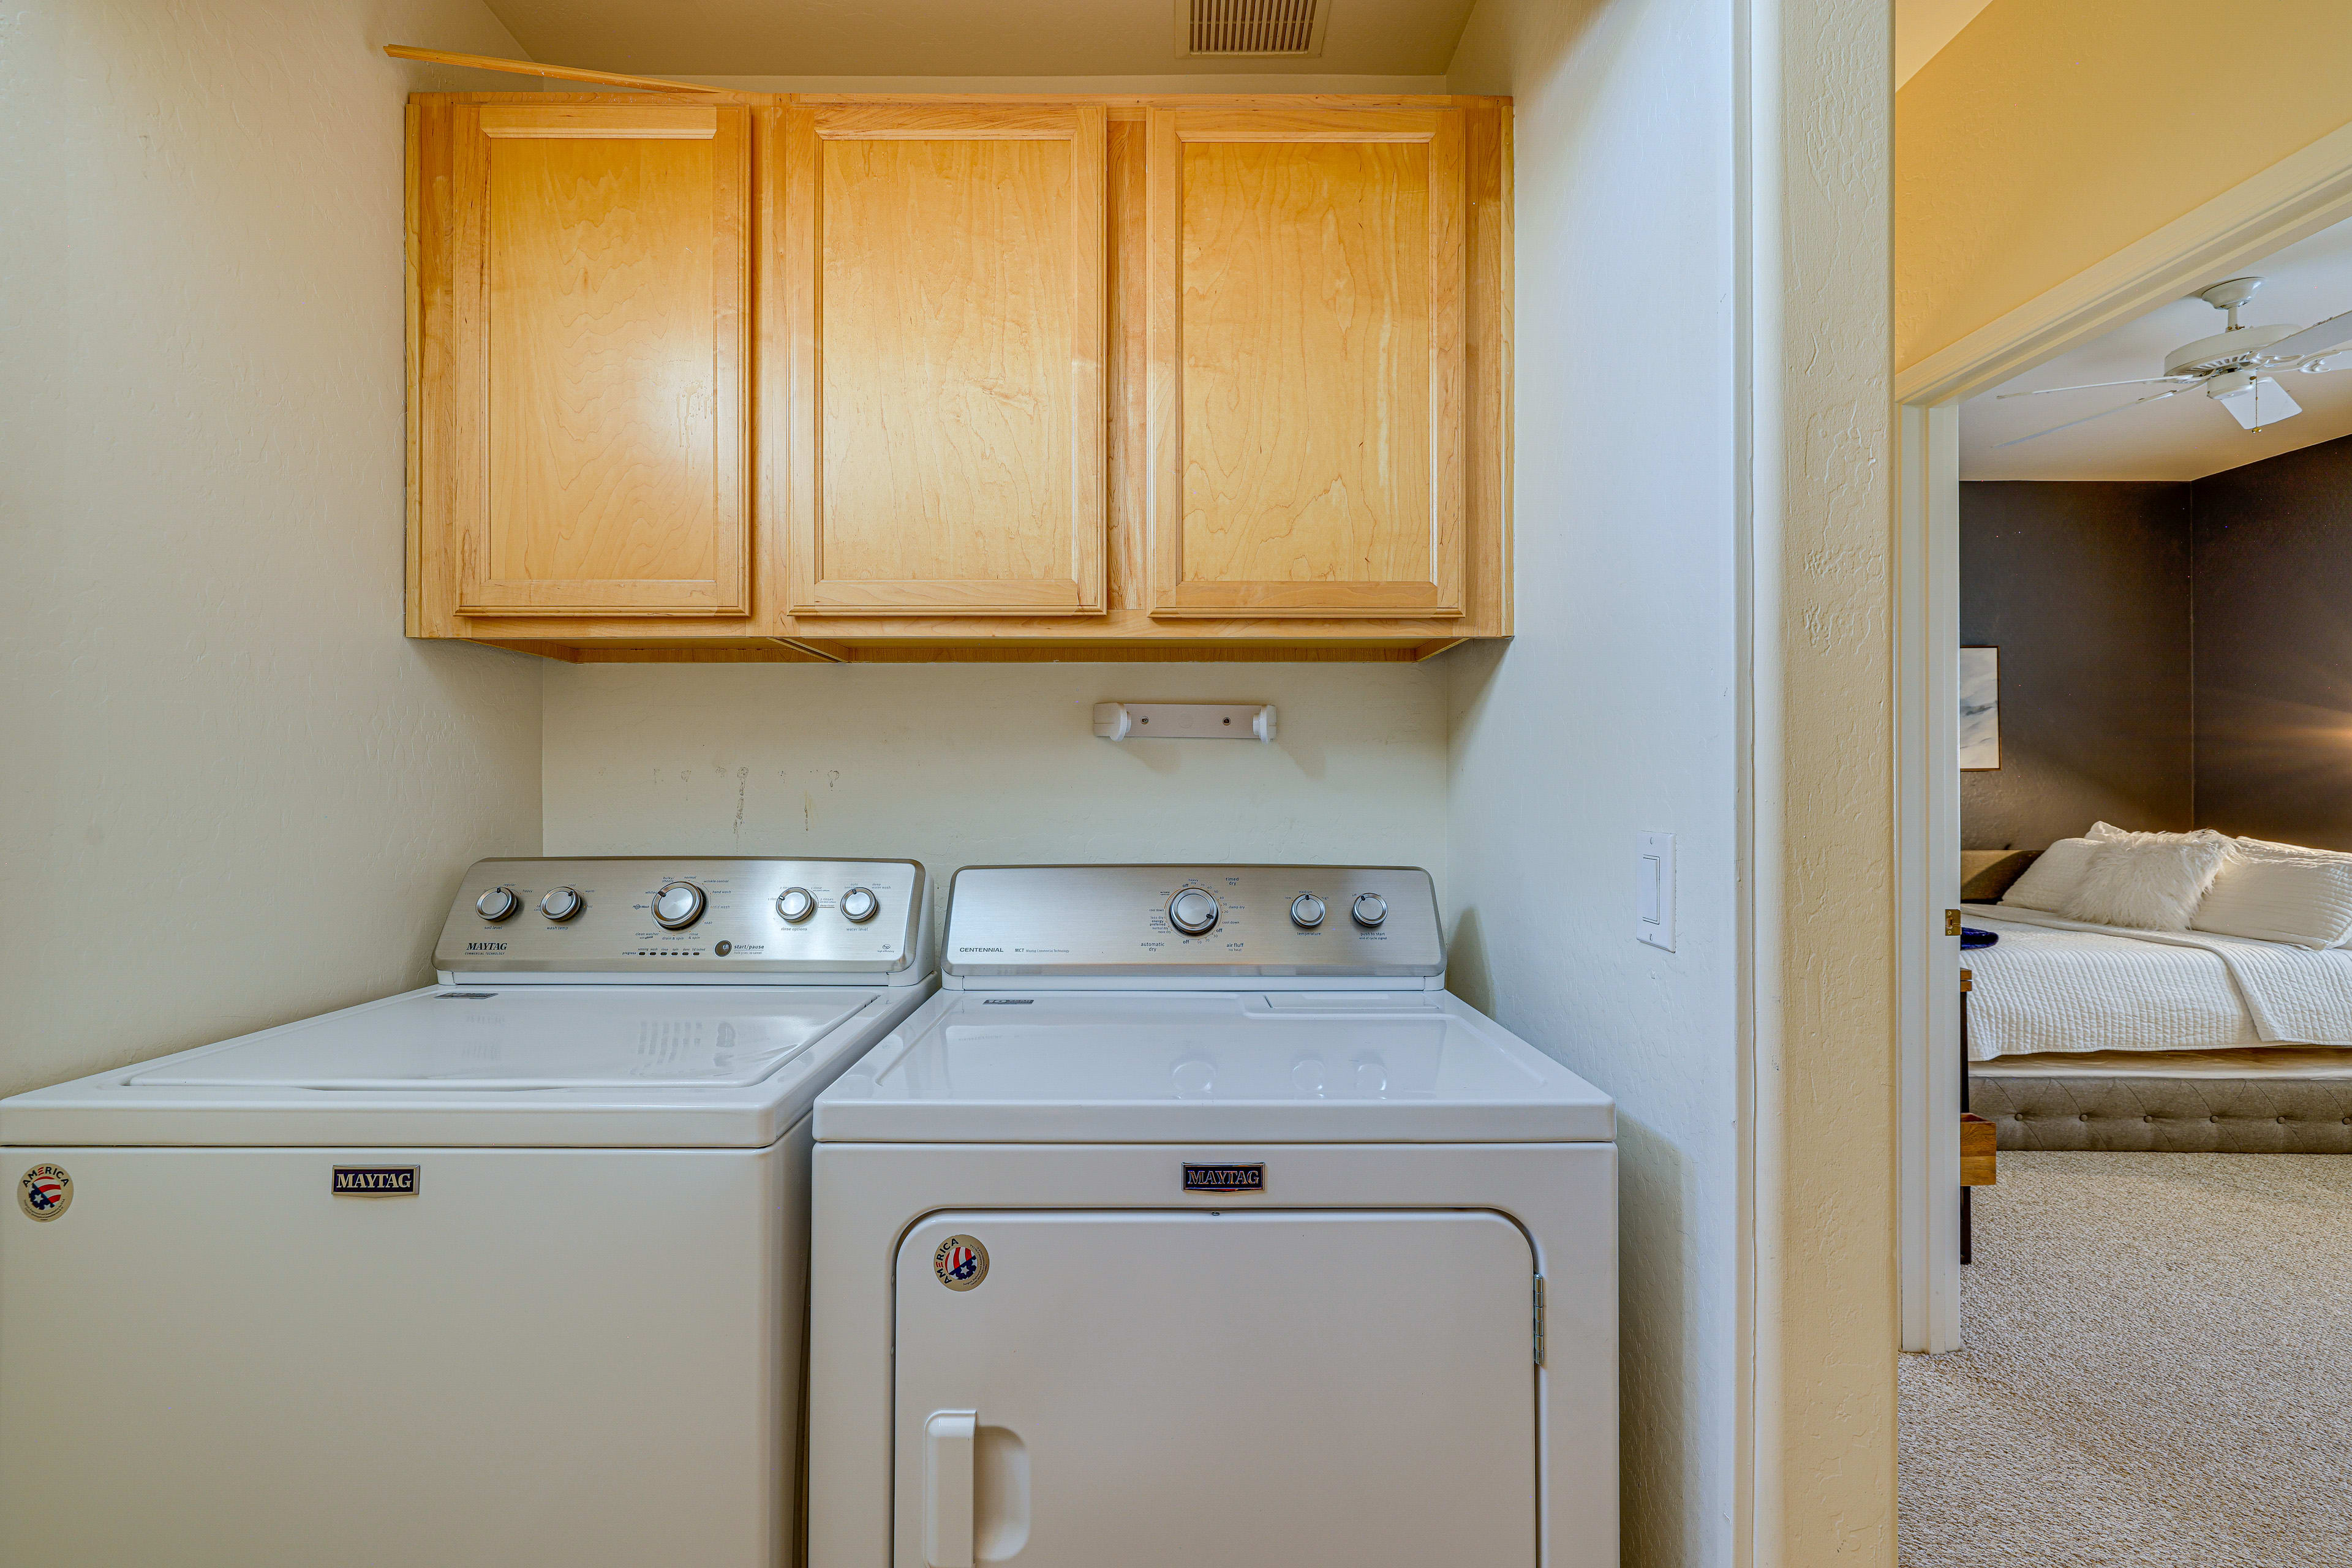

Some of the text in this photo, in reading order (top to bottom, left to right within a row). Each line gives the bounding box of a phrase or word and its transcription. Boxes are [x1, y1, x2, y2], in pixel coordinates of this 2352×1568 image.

[23, 1166, 69, 1188] AMERICA
[336, 1174, 412, 1188] MAYTAG
[1188, 1170, 1259, 1185] MAYTAG
[935, 1238, 959, 1284] AMERICA
